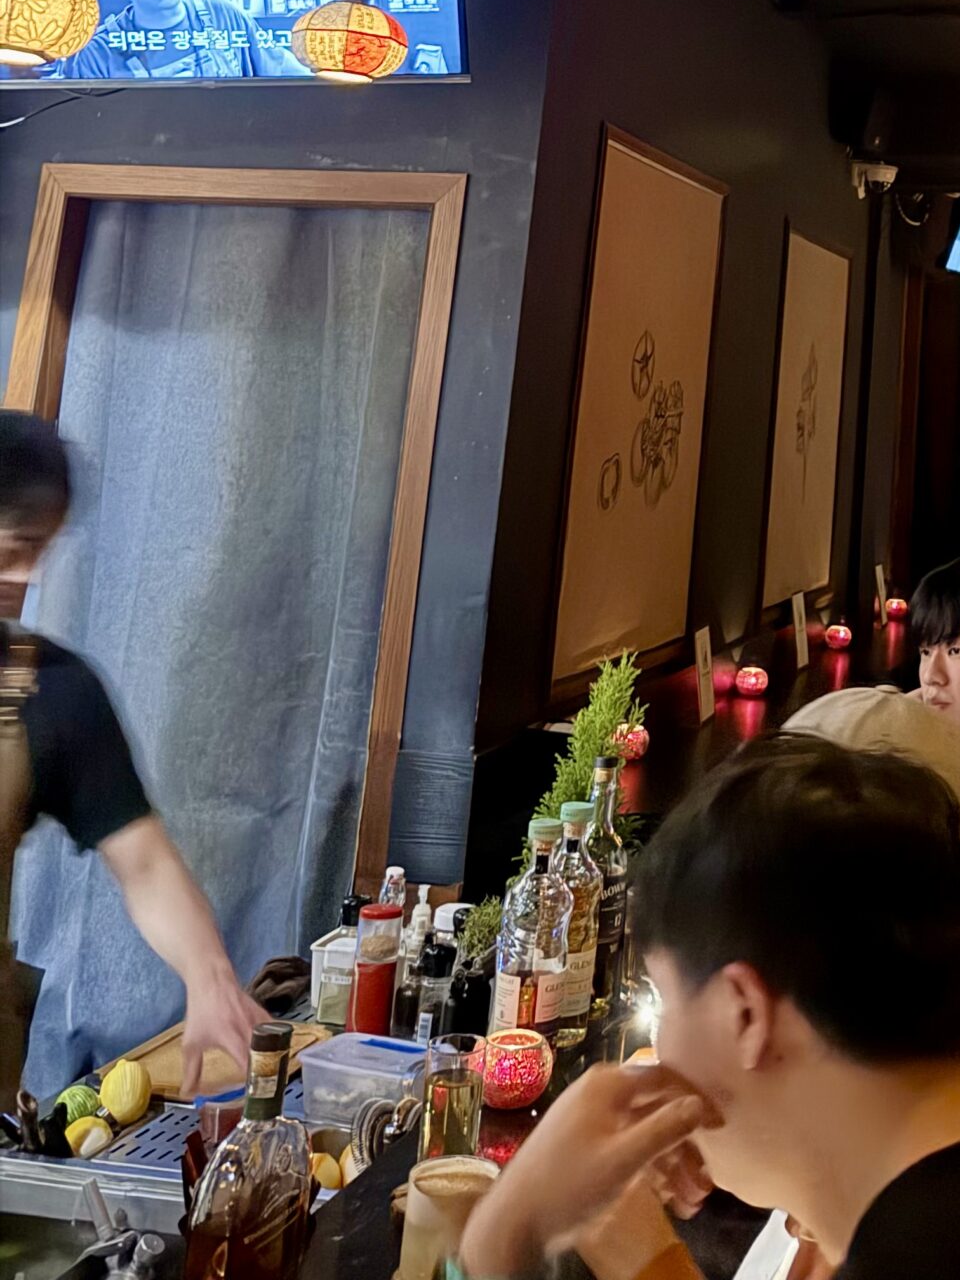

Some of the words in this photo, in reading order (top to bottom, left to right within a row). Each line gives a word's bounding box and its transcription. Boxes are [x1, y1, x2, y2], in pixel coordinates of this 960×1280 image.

[108, 30, 166, 51] 되면은
[171, 29, 250, 50] 광복절도
[255, 29, 292, 48] 있고
